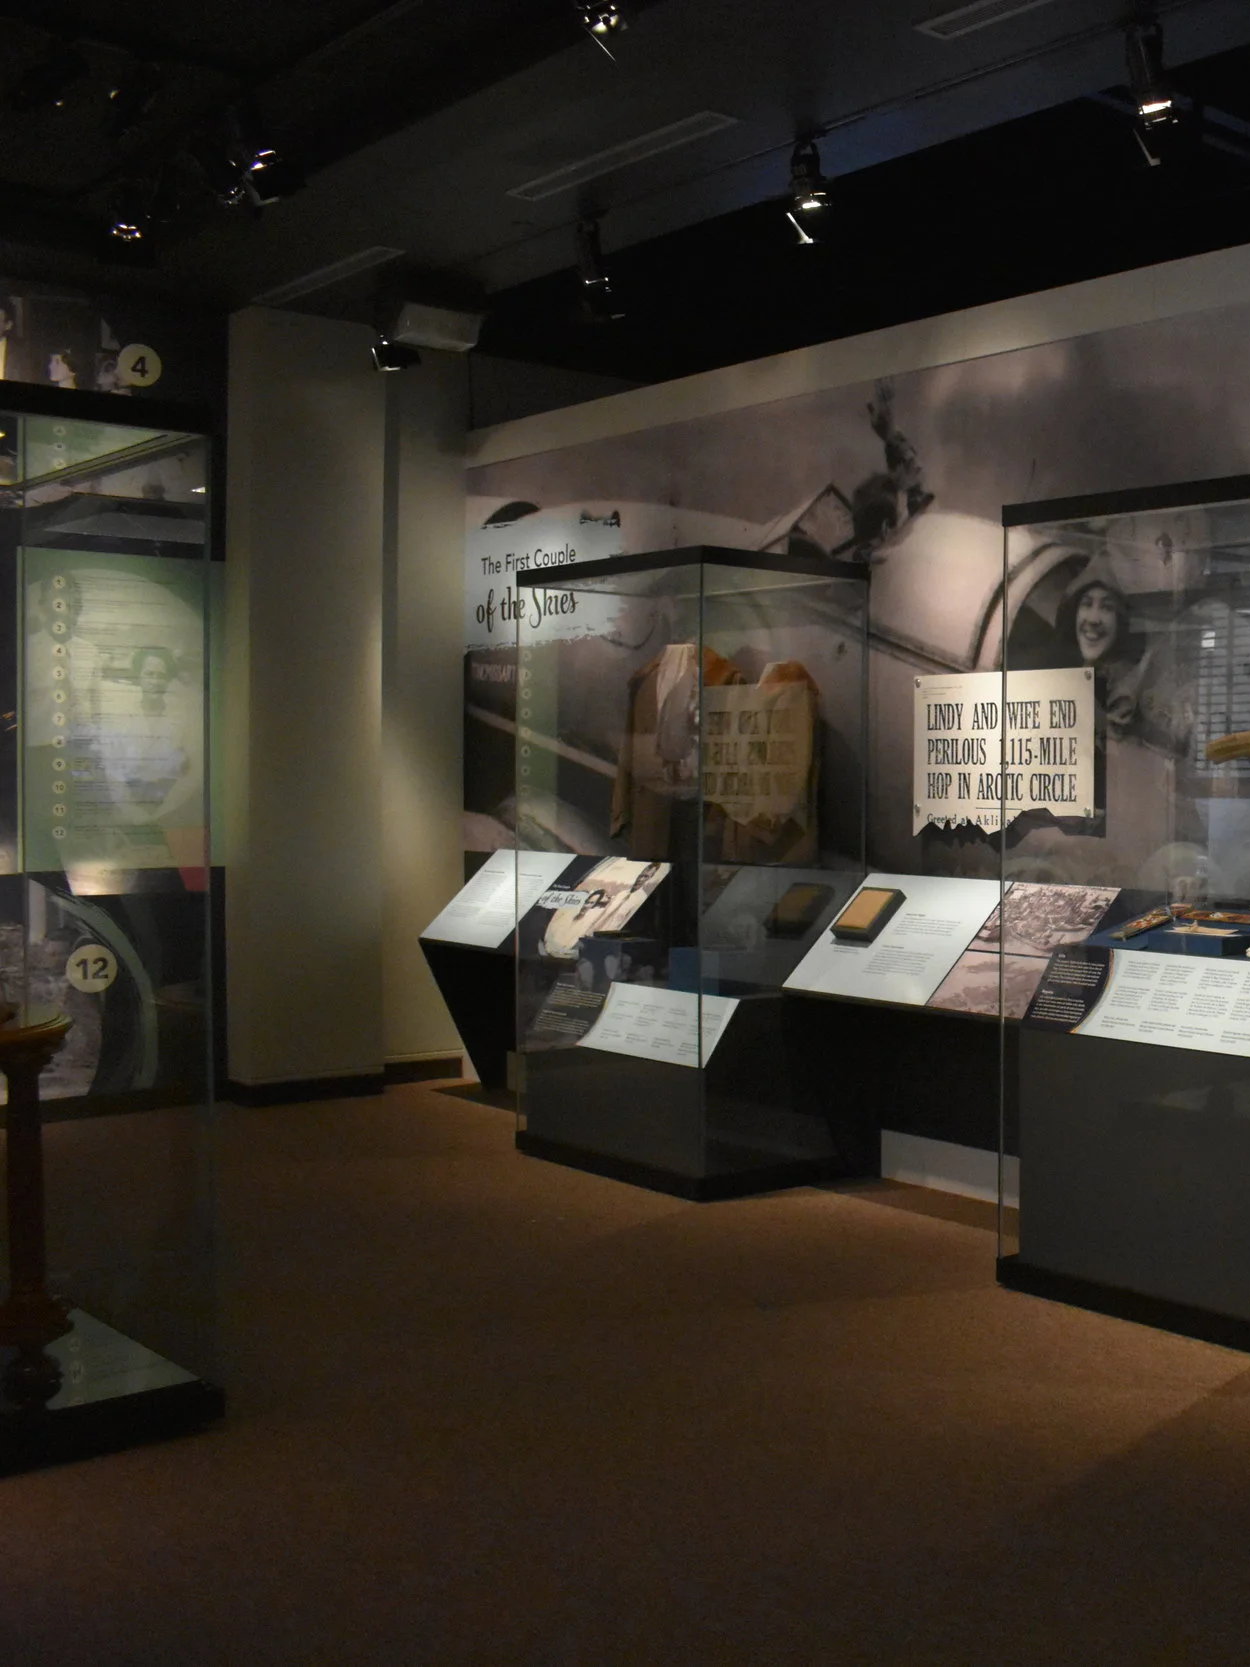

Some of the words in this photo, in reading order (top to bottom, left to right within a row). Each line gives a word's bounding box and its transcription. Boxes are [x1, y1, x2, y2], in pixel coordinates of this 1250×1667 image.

[131, 356, 149, 378] 4
[481, 555, 501, 575] The
[505, 553, 530, 573] First
[534, 543, 576, 567] Couple
[476, 588, 497, 633] of
[500, 586, 526, 621] the
[529, 587, 579, 629] Skies
[927, 703, 963, 731] LINDY
[972, 702, 998, 730] AND
[1006, 701, 1040, 730] WIFE
[1049, 700, 1077, 729] END
[927, 738, 987, 765] PERILOUS
[927, 772, 952, 799] HOP
[958, 772, 971, 799] IN
[976, 773, 1023, 801] ARCTIC
[1029, 773, 1078, 802] CIRCLE
[976, 816, 1017, 827] Aklia
[75, 957, 110, 981] 12
